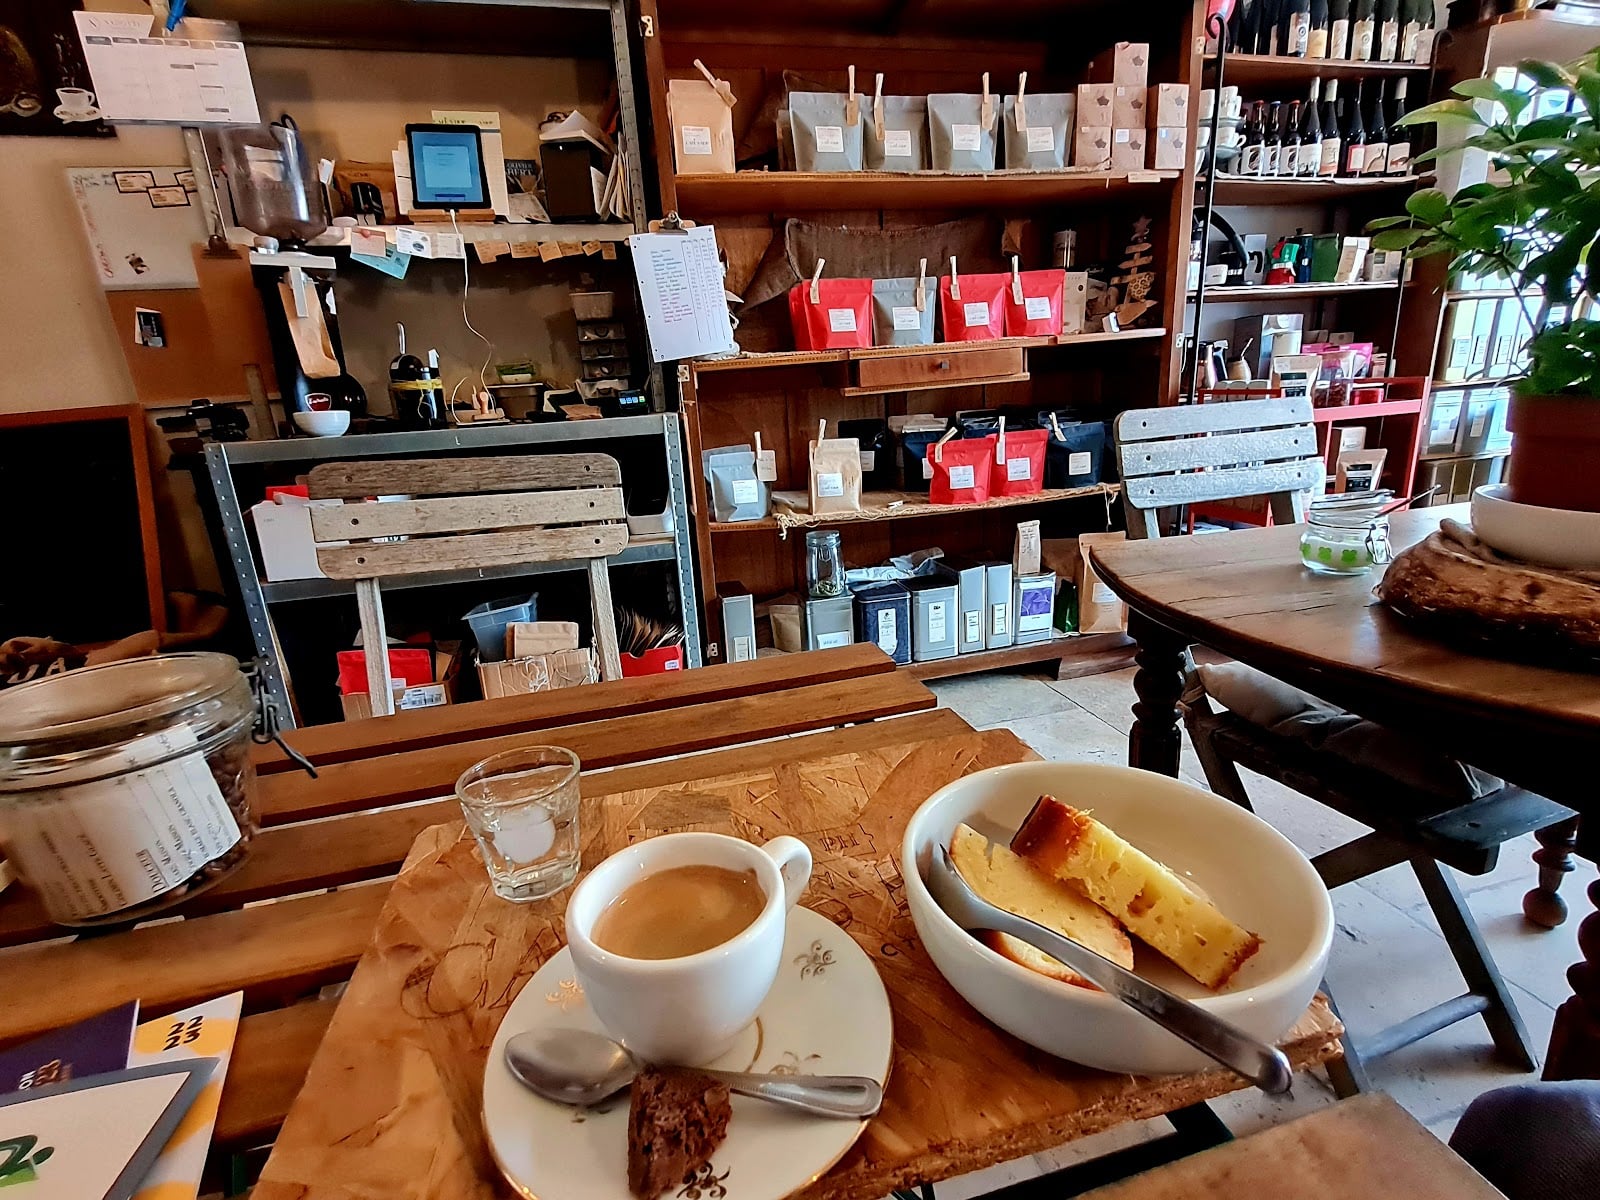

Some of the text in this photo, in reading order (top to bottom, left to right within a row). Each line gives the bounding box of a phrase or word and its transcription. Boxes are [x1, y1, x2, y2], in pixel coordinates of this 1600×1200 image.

[135, 849, 166, 893] DOUCEUR
[162, 1026, 202, 1051] 23
[167, 1015, 204, 1037] 22
